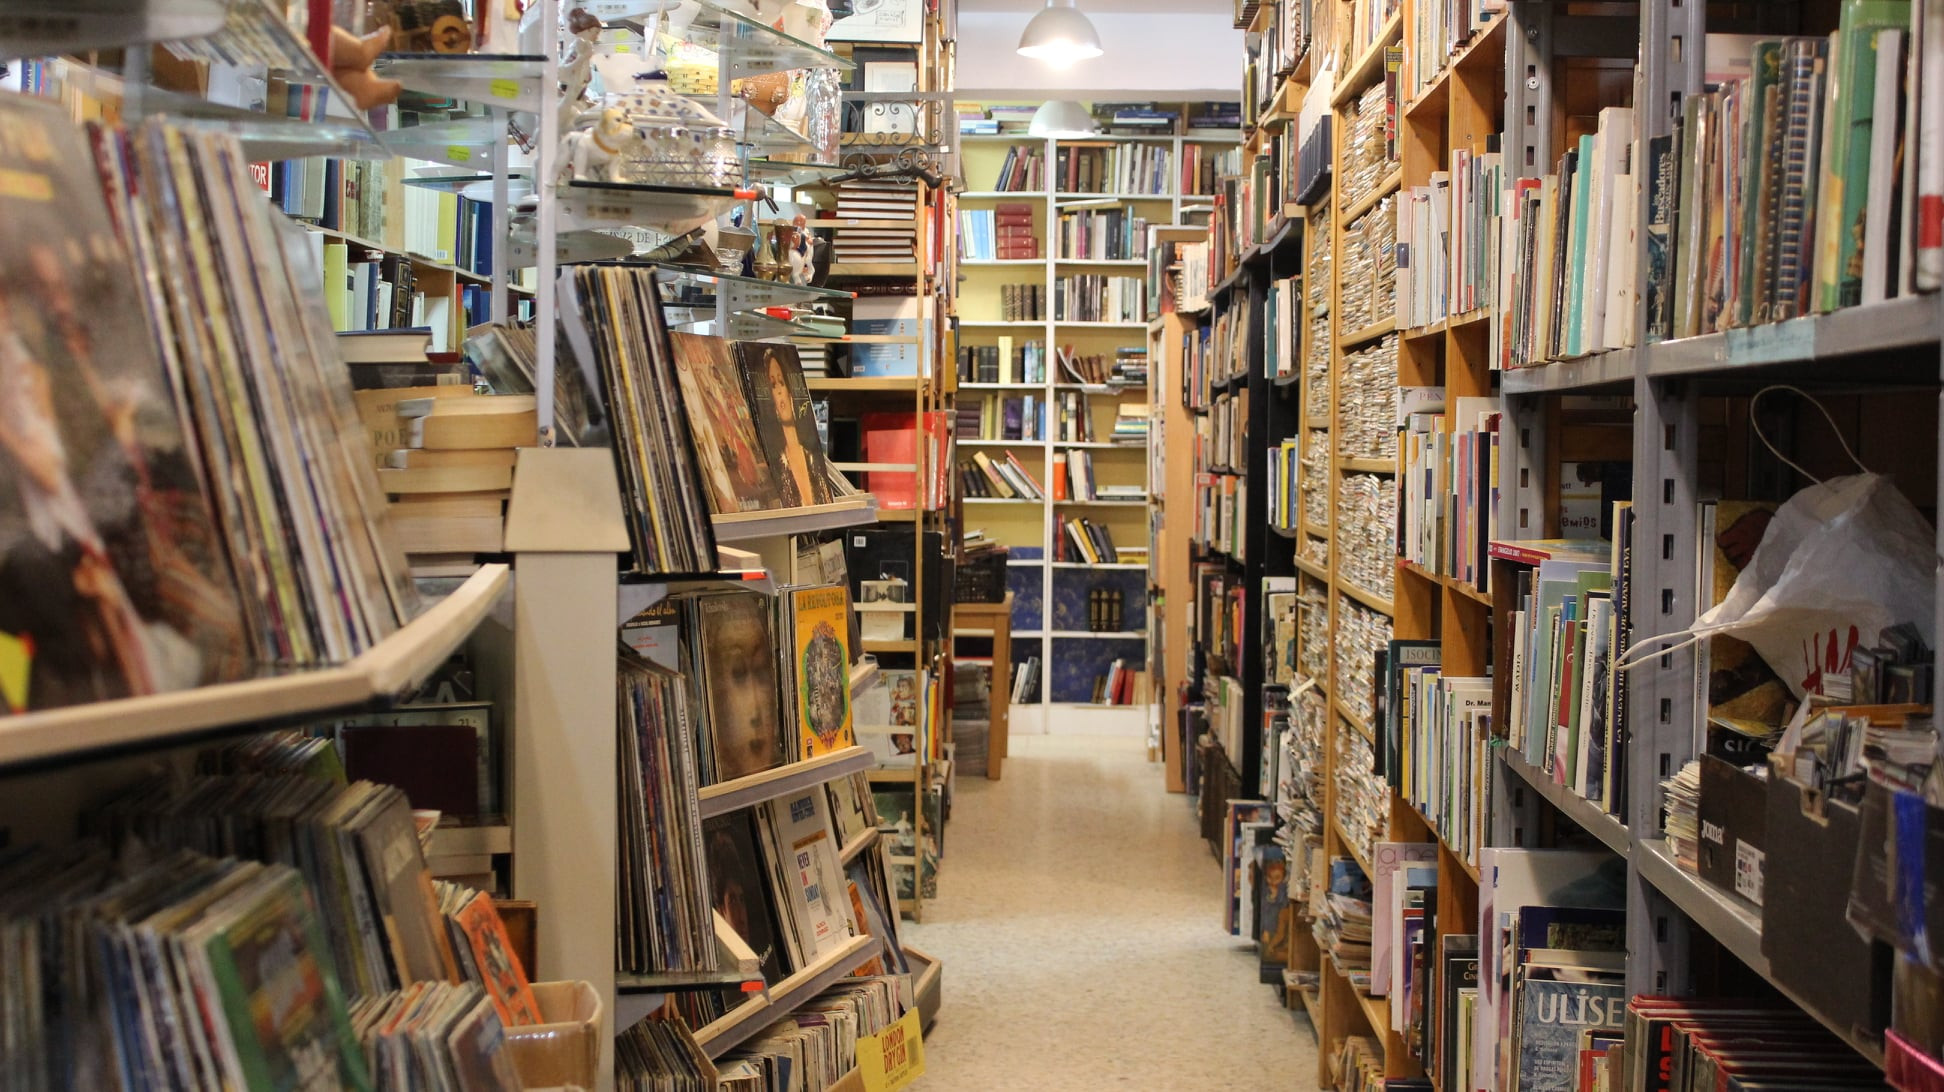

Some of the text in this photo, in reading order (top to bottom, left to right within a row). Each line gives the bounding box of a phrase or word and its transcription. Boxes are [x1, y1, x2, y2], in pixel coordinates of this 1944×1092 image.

[247, 164, 267, 185] TOR
[1654, 153, 1666, 224] Buscadores
[1623, 546, 1631, 568] EVA
[1620, 614, 1627, 630] DE
[1616, 728, 1622, 743] LA
[881, 1025, 905, 1053] LONDON
[883, 1044, 906, 1074] DRY GIN
